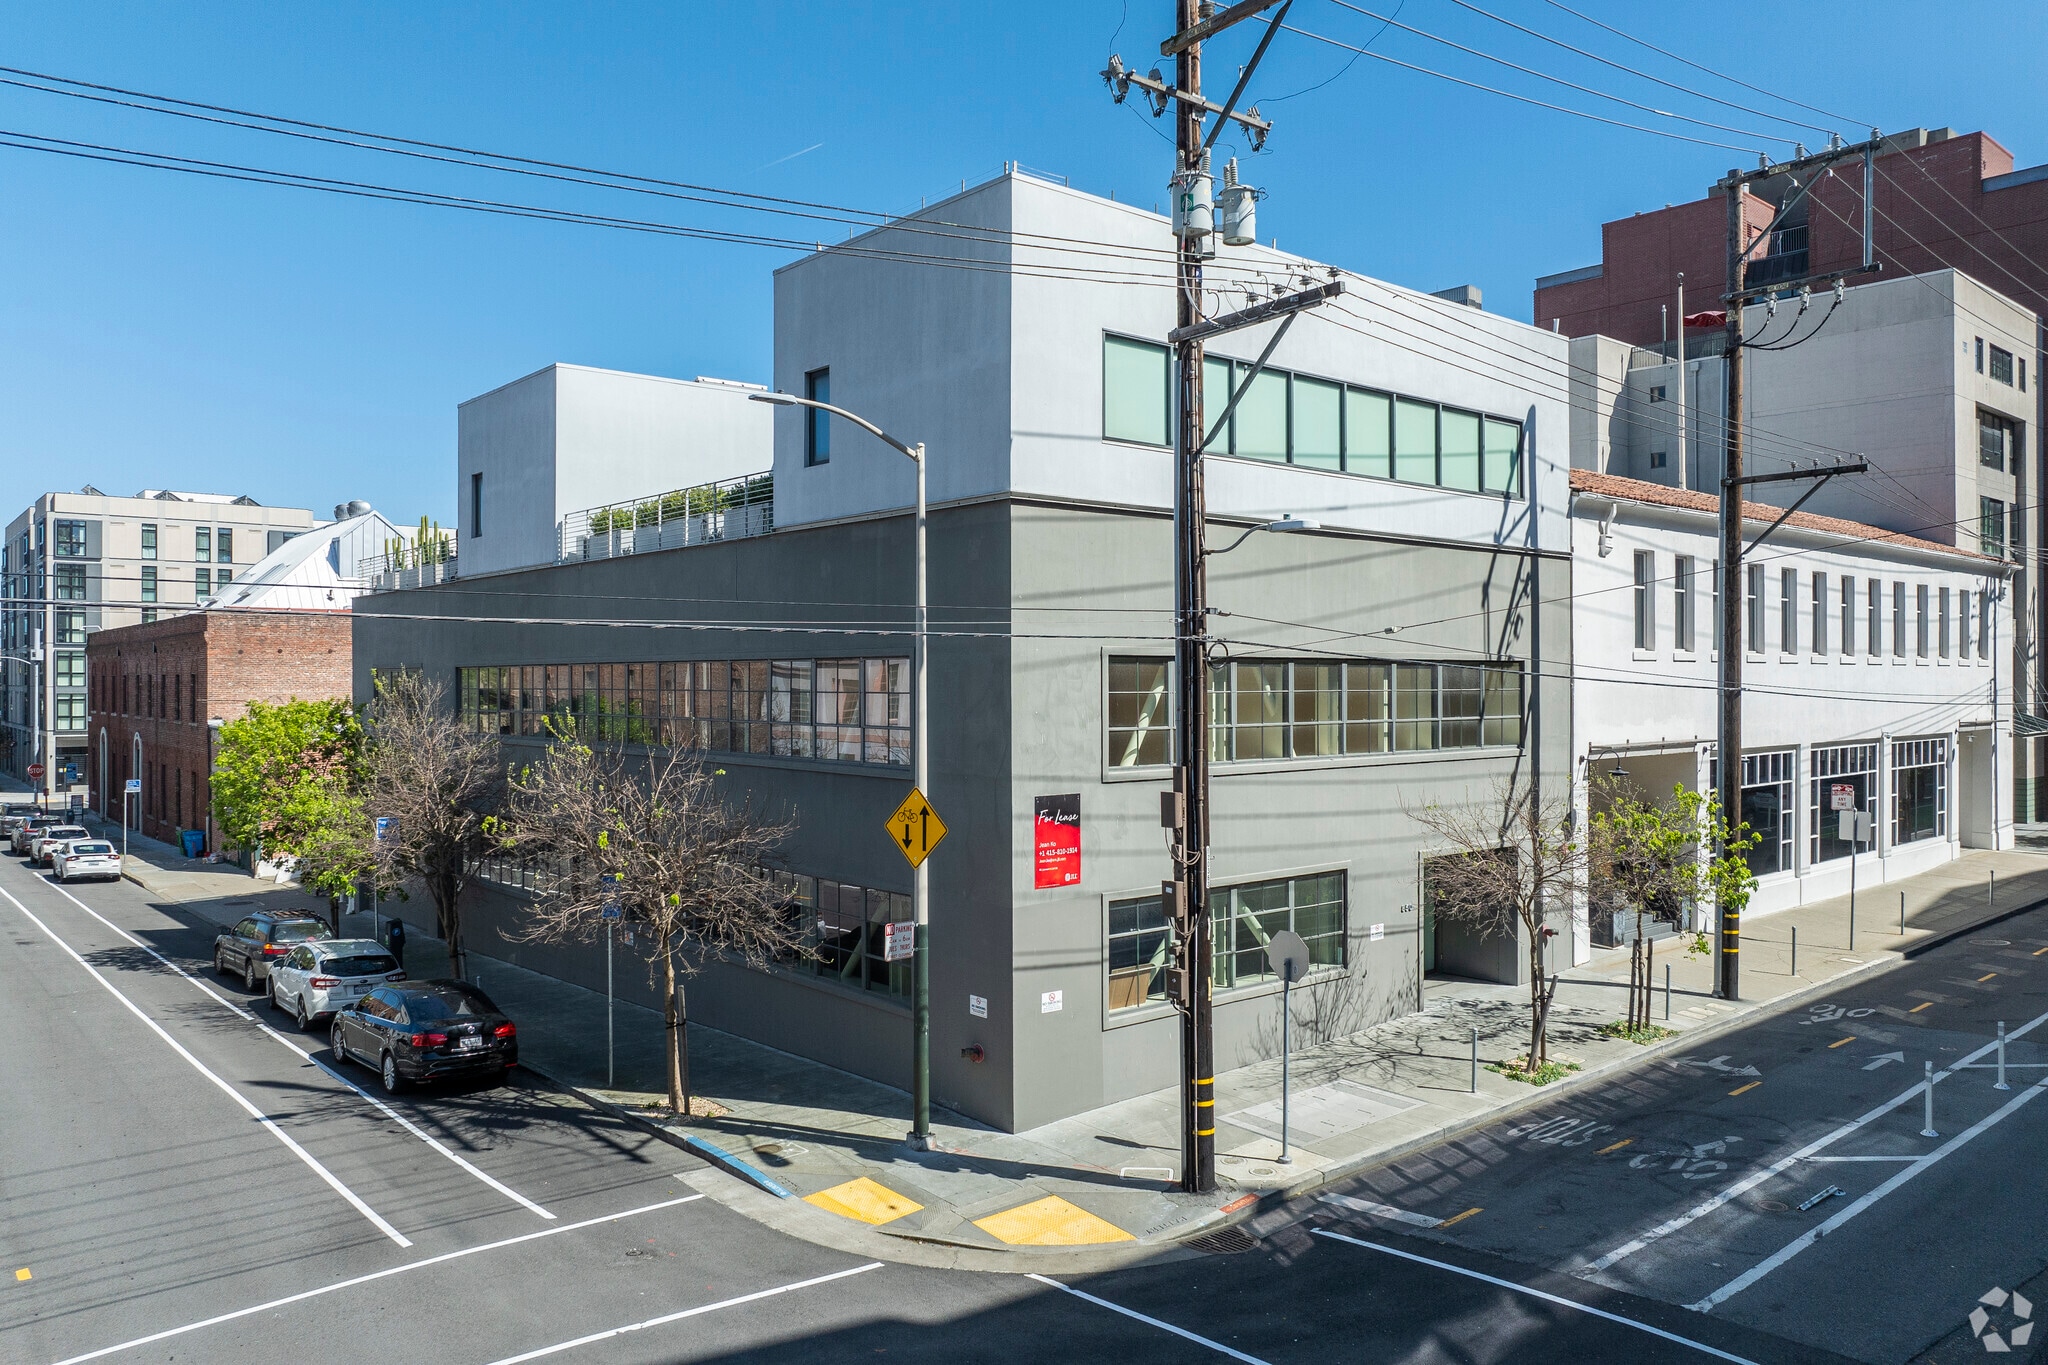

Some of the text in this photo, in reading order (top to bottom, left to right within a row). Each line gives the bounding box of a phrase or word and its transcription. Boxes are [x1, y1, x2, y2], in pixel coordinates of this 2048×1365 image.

[1038, 809, 1079, 825] For Lease
[886, 925, 894, 935] NO
[1507, 1116, 1615, 1146] STOP
